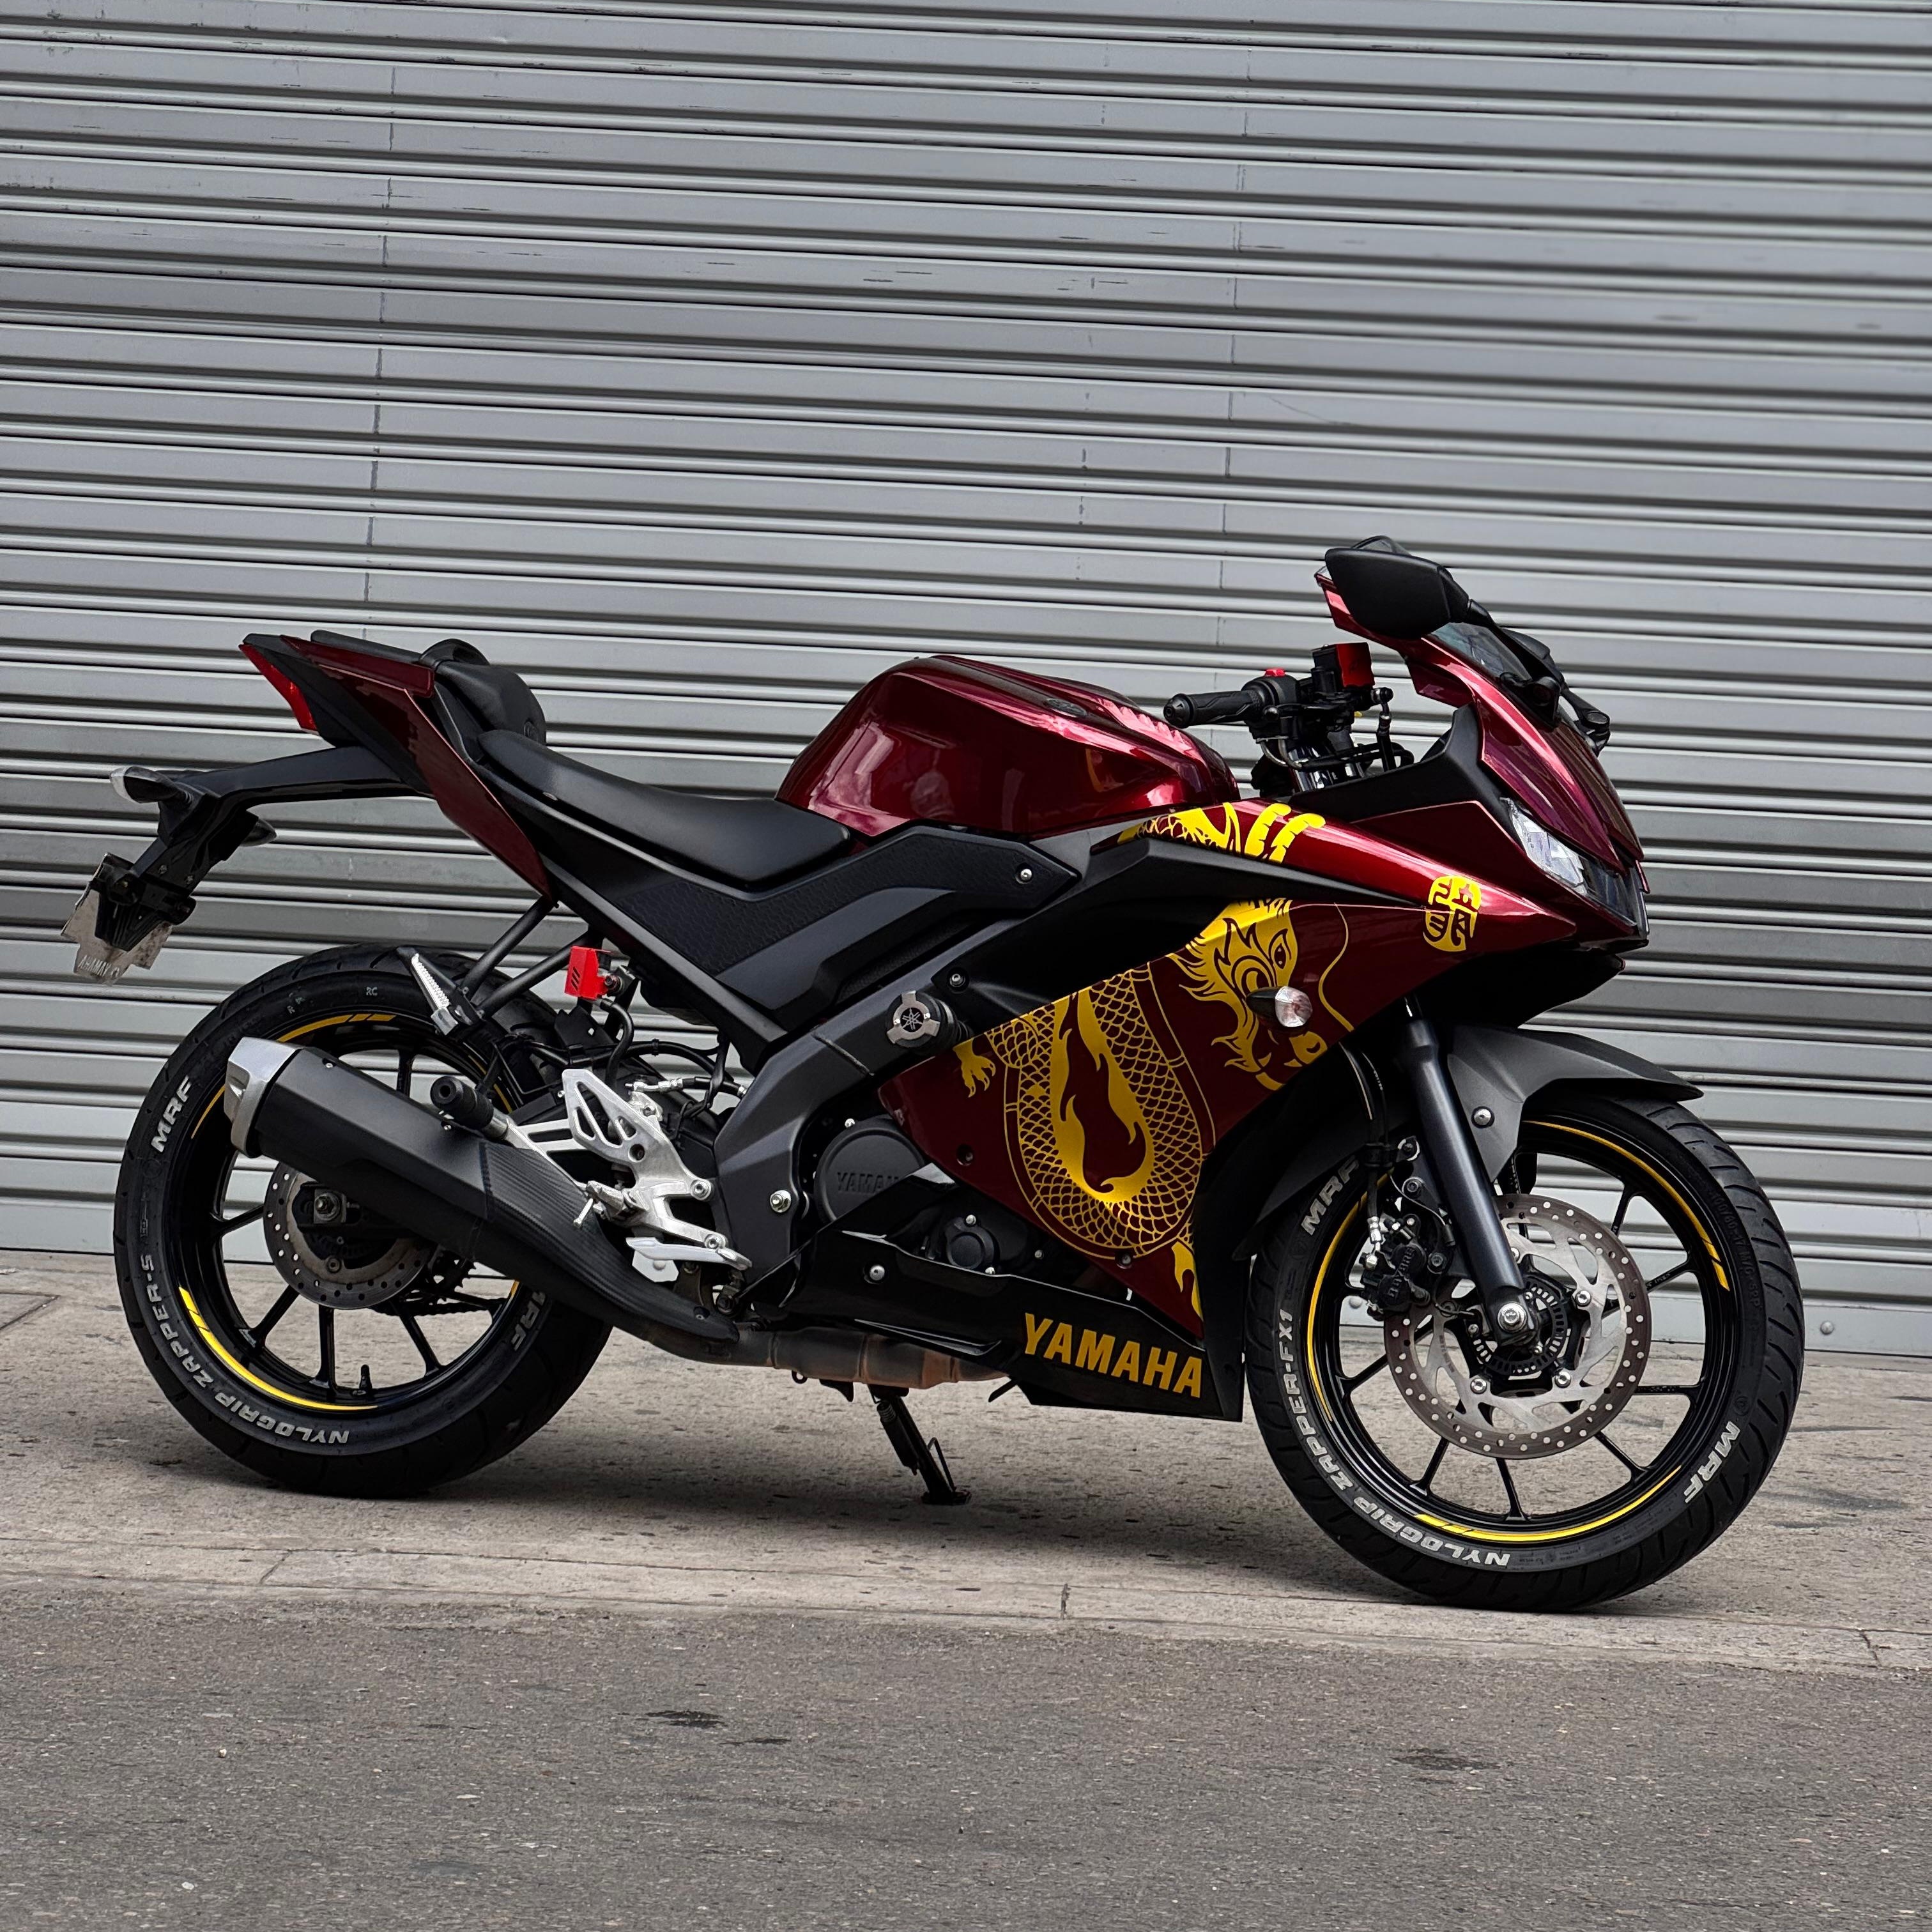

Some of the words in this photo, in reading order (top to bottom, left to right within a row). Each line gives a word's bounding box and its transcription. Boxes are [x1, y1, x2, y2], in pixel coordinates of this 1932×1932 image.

[366, 986, 378, 996] RC
[151, 1074, 192, 1153] MRF
[837, 1172, 900, 1193] YAMA
[1301, 1154, 1359, 1236] MRF
[140, 1254, 215, 1388] ZAPPER-S
[1025, 1312, 1202, 1399] YAMAHA
[215, 1392, 349, 1444] NYLOGRIP
[1278, 1309, 1354, 1491] ZAPPER-FX1
[1683, 1421, 1741, 1503] MRF
[1353, 1496, 1510, 1566] NYLOGRIP
